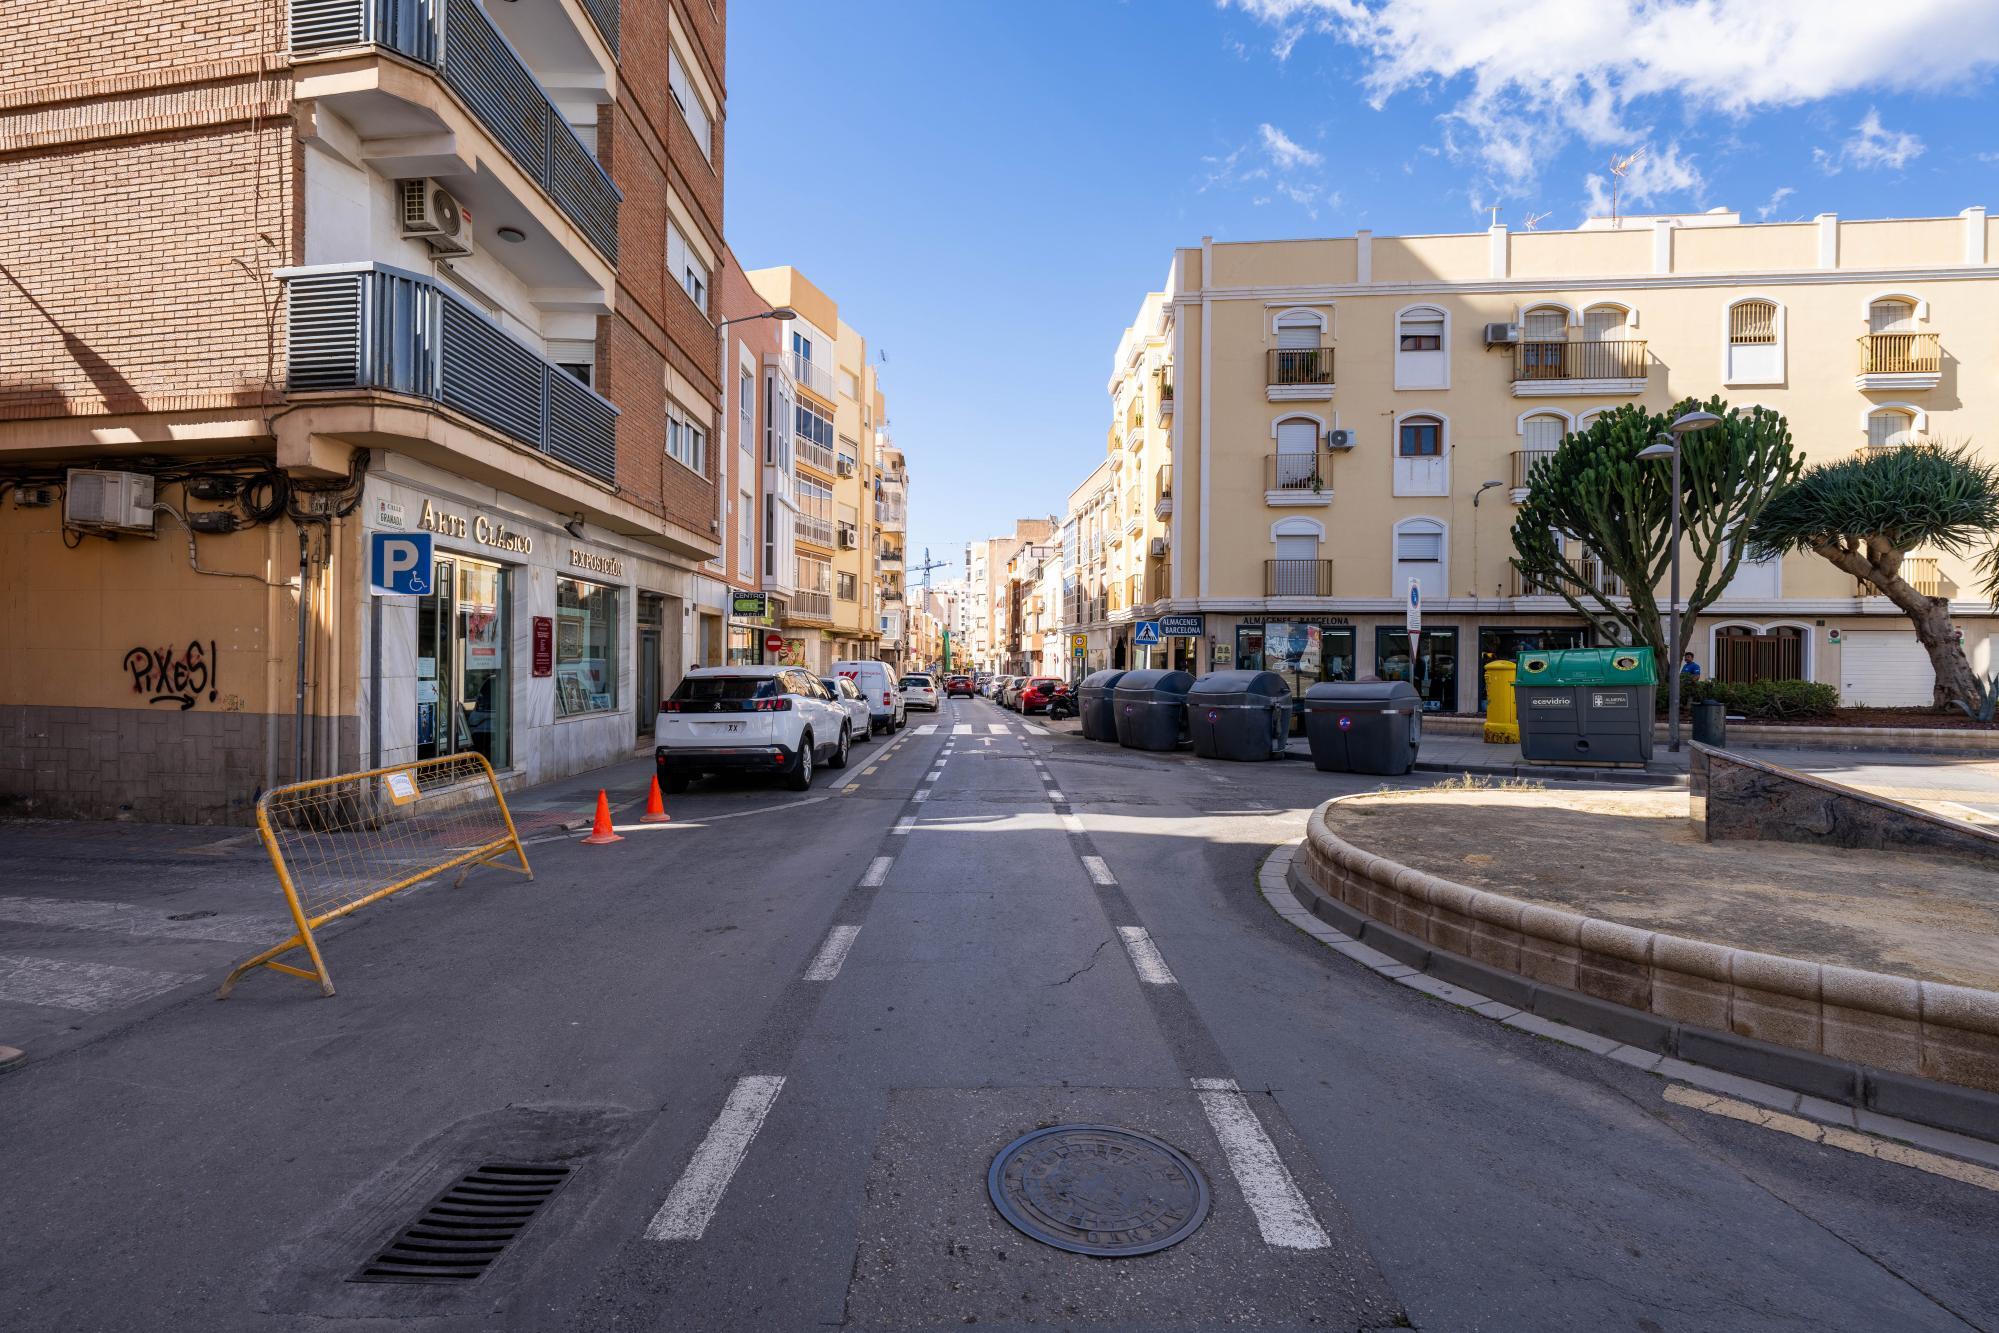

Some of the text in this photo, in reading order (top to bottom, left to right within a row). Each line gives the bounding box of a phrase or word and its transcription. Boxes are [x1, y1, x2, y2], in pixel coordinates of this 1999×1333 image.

[383, 540, 419, 588] P
[570, 549, 623, 577] EXPOSICIÓN
[1162, 618, 1198, 626] ALMACENES
[1243, 616, 1349, 625] ALMACENES BARCELONA
[1165, 626, 1201, 634] BARCELONA
